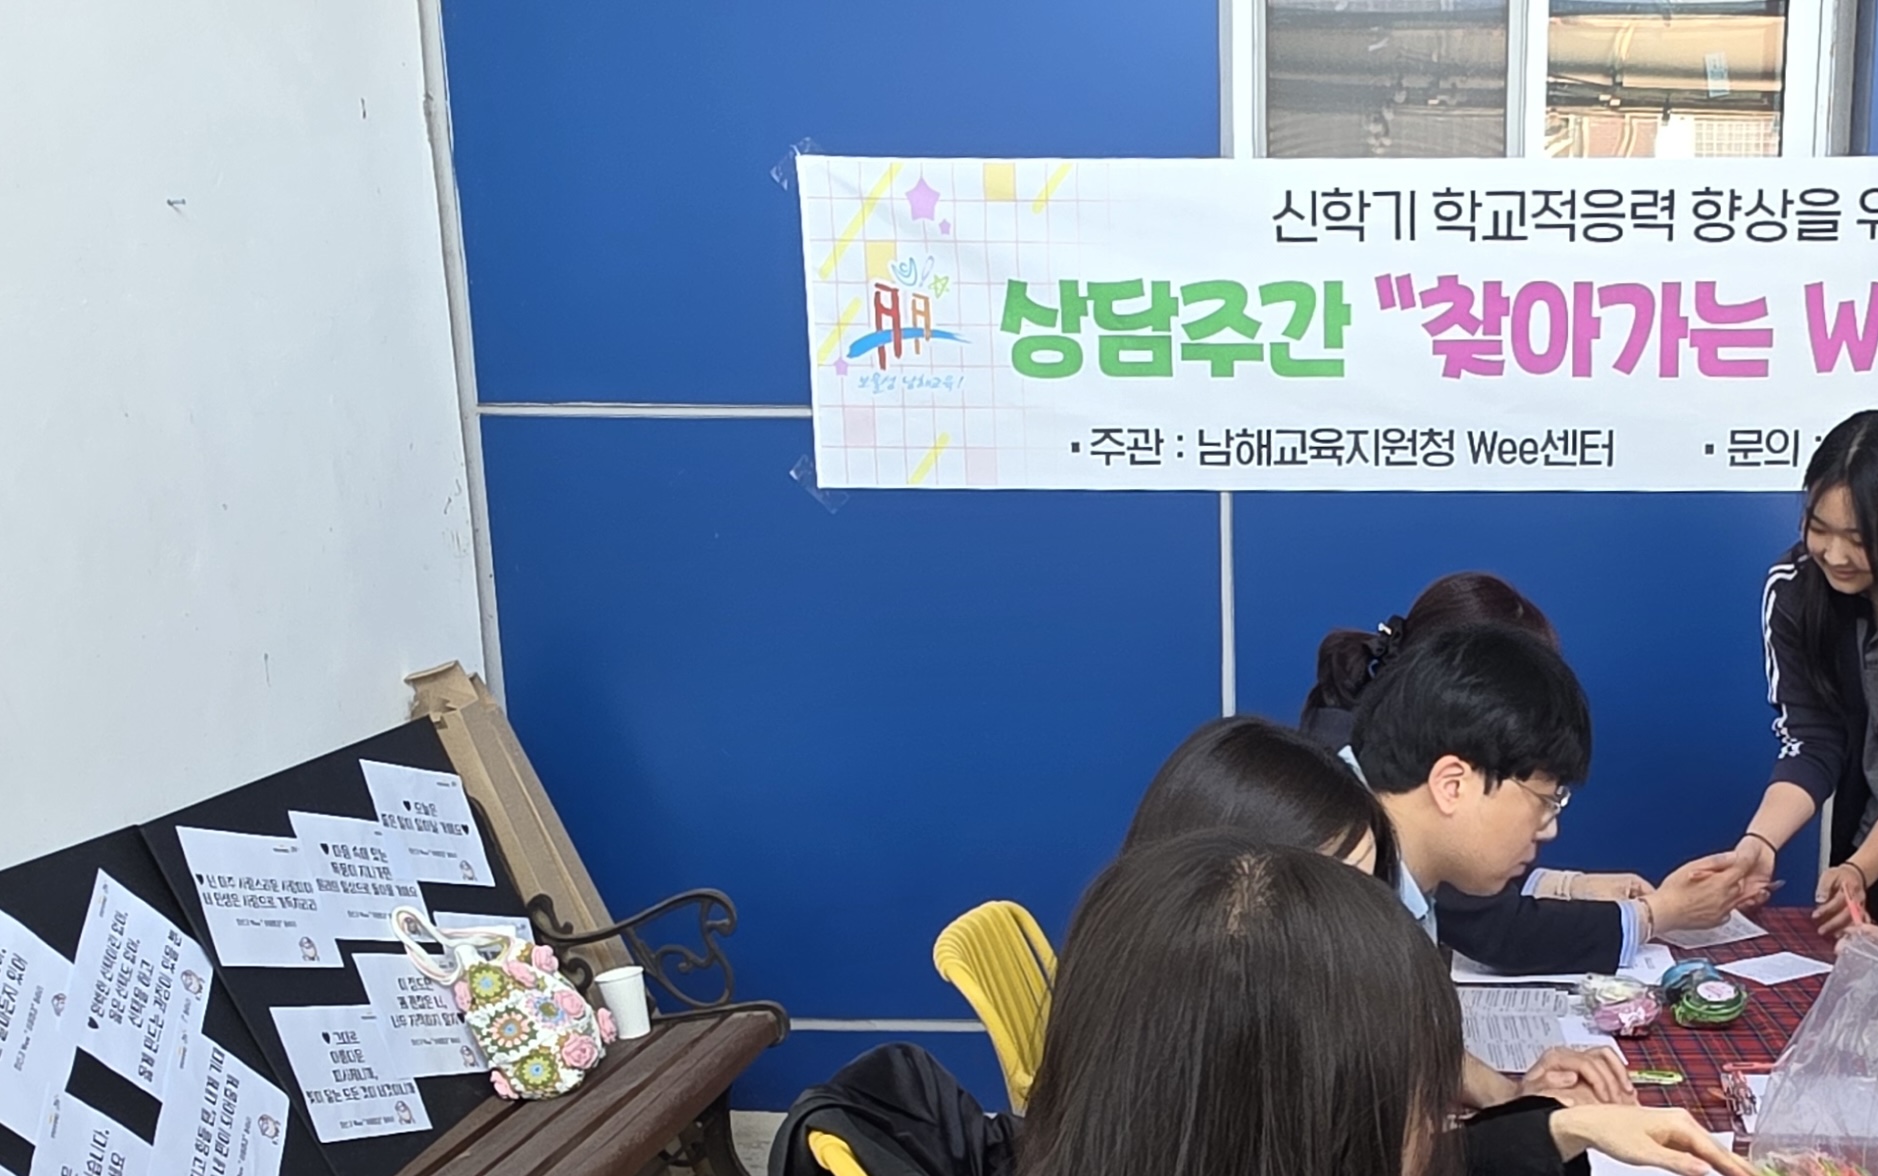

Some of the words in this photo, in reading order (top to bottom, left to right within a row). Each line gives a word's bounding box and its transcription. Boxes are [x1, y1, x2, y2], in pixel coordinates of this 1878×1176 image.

[1273, 188, 1417, 244] 신학기
[1433, 188, 1676, 244] 학교적응력
[1692, 187, 1843, 244] 향상을
[1000, 279, 1352, 379] 상담주간
[1375, 274, 1774, 379] "찾아가는
[1091, 429, 1166, 467] 주관
[1199, 429, 1456, 468] 남해교육지원청
[1468, 430, 1615, 468] Wee센터
[1728, 430, 1800, 469] 문의
[413, 801, 437, 818] 오늘은
[6, 953, 28, 986] 있어
[194, 1126, 213, 1157] 힘들
